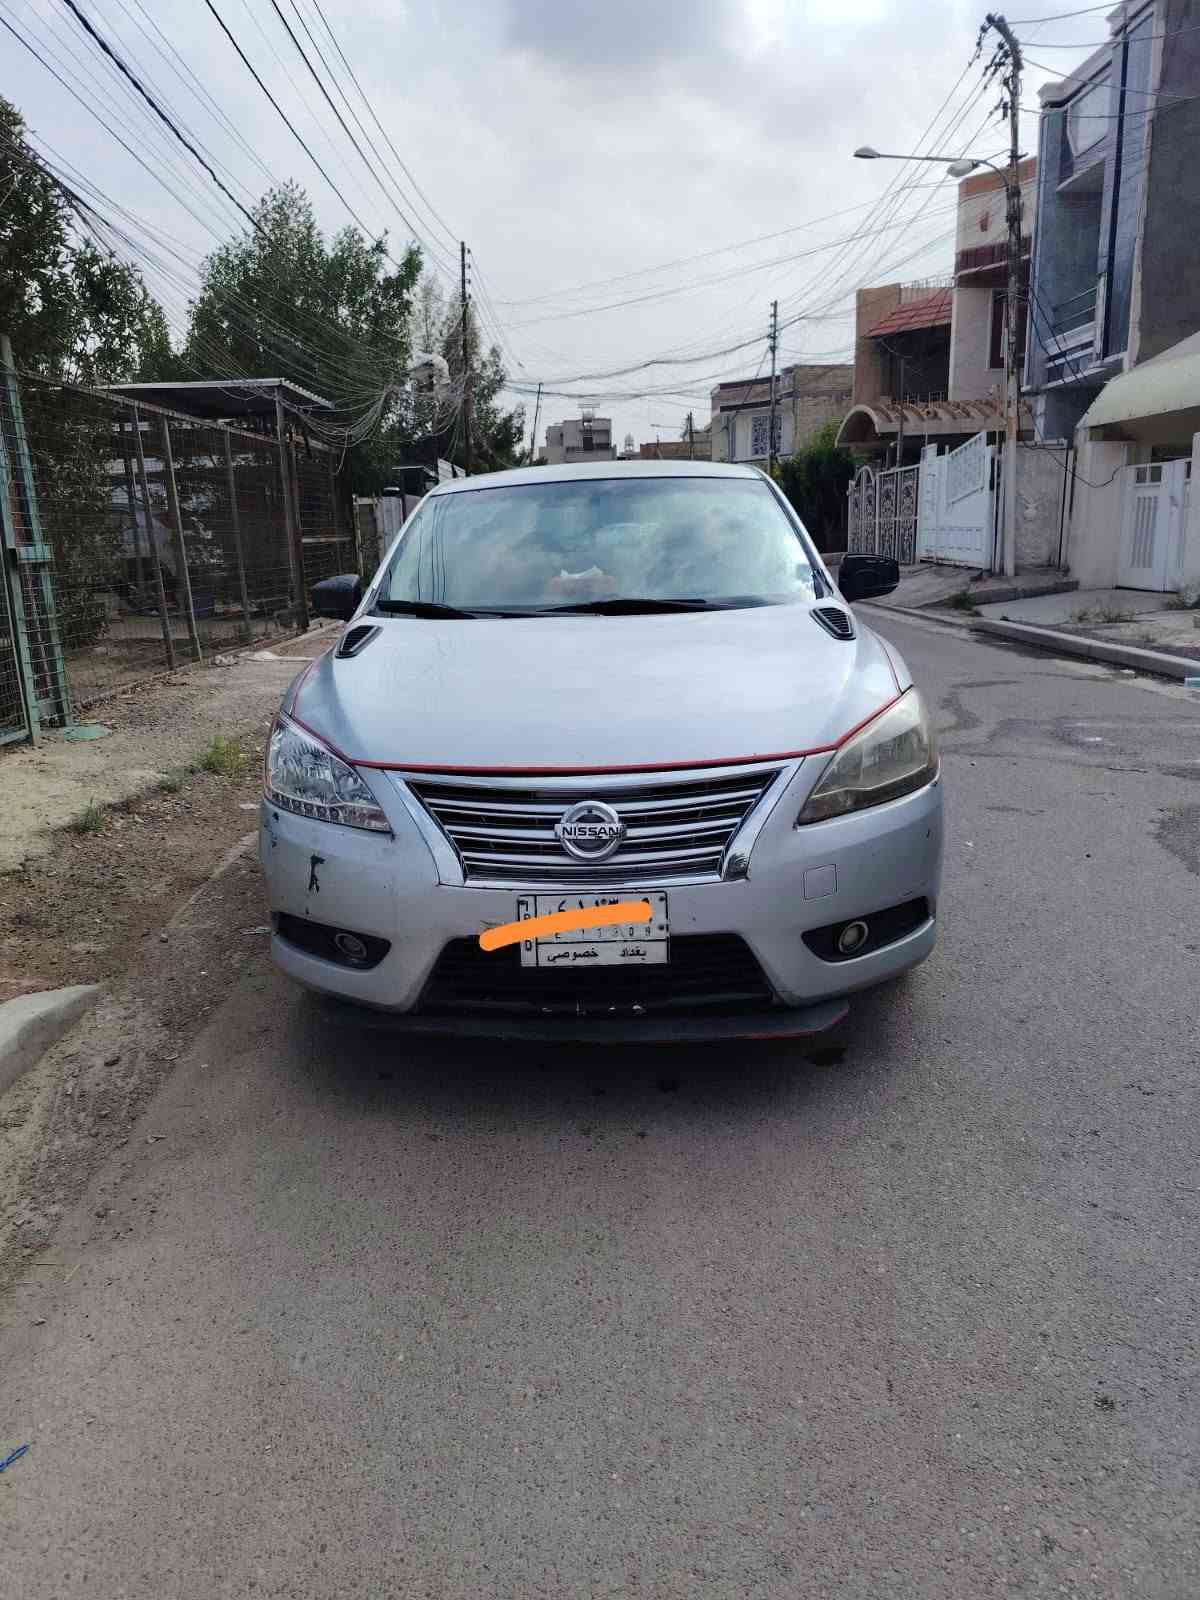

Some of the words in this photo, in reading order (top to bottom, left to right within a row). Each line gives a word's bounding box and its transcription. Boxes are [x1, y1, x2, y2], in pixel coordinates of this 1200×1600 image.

[562, 826, 619, 836] NISSAN
[547, 947, 599, 962] خصوصي
[619, 948, 647, 961] بغداد
